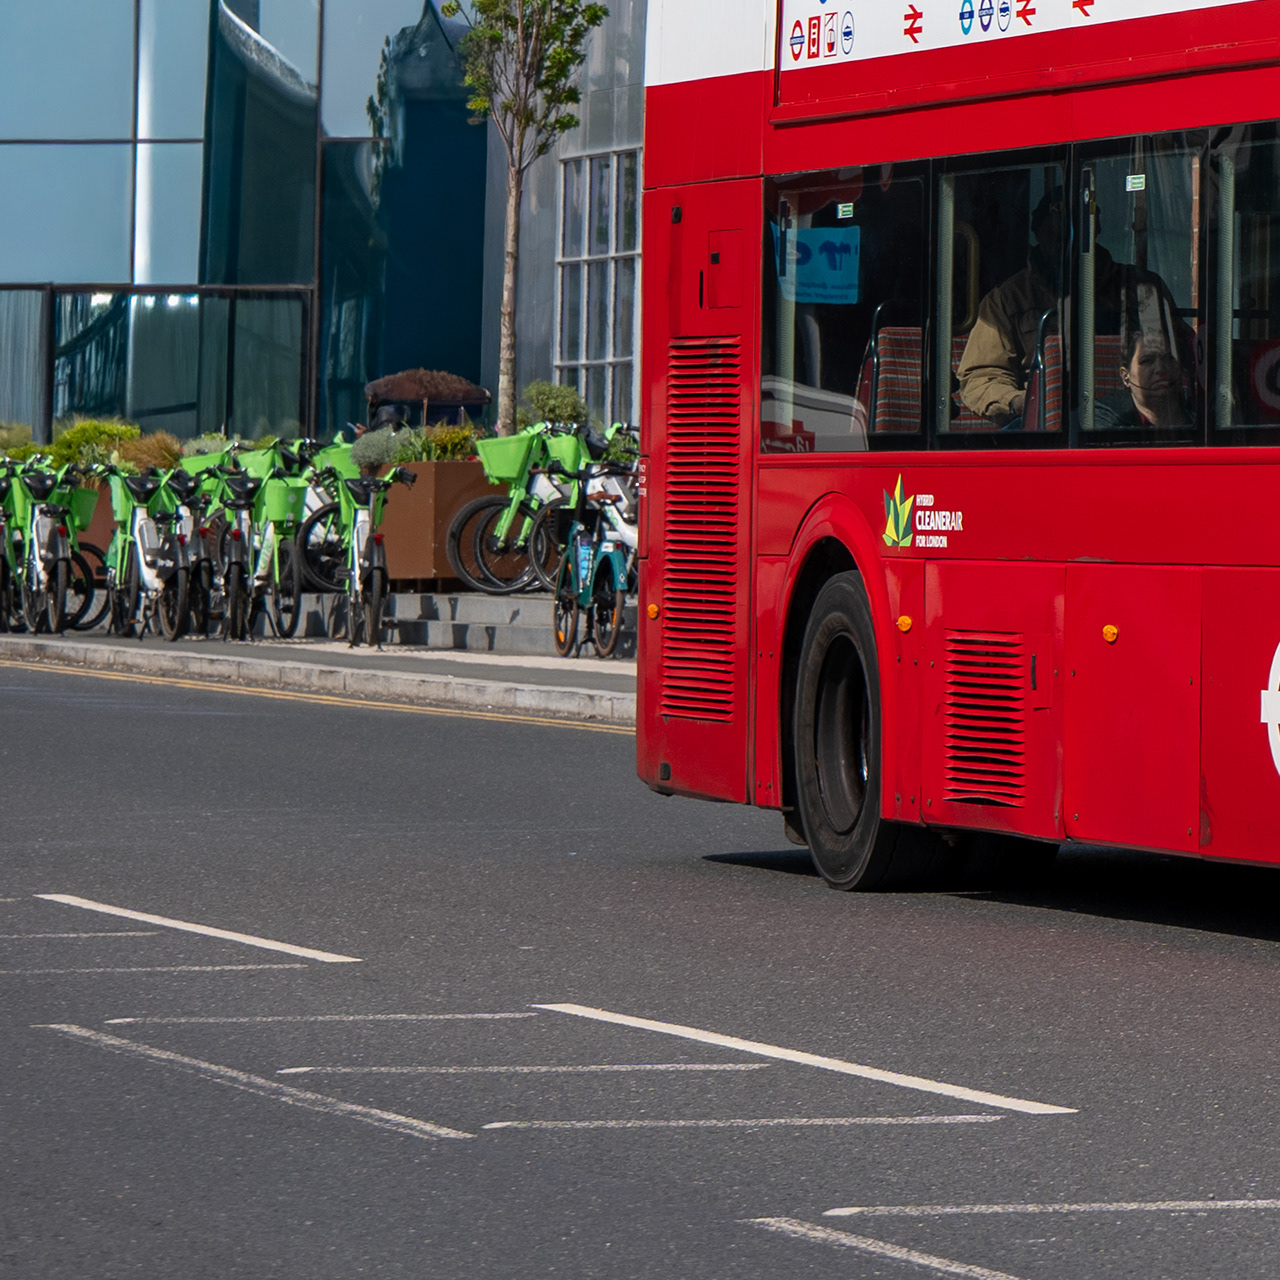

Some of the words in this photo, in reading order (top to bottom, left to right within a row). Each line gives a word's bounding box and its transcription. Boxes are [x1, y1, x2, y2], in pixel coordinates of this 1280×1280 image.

[915, 510, 963, 531] CLEANERAIR
[915, 535, 926, 548] FOR
[926, 535, 948, 548] LONDON
